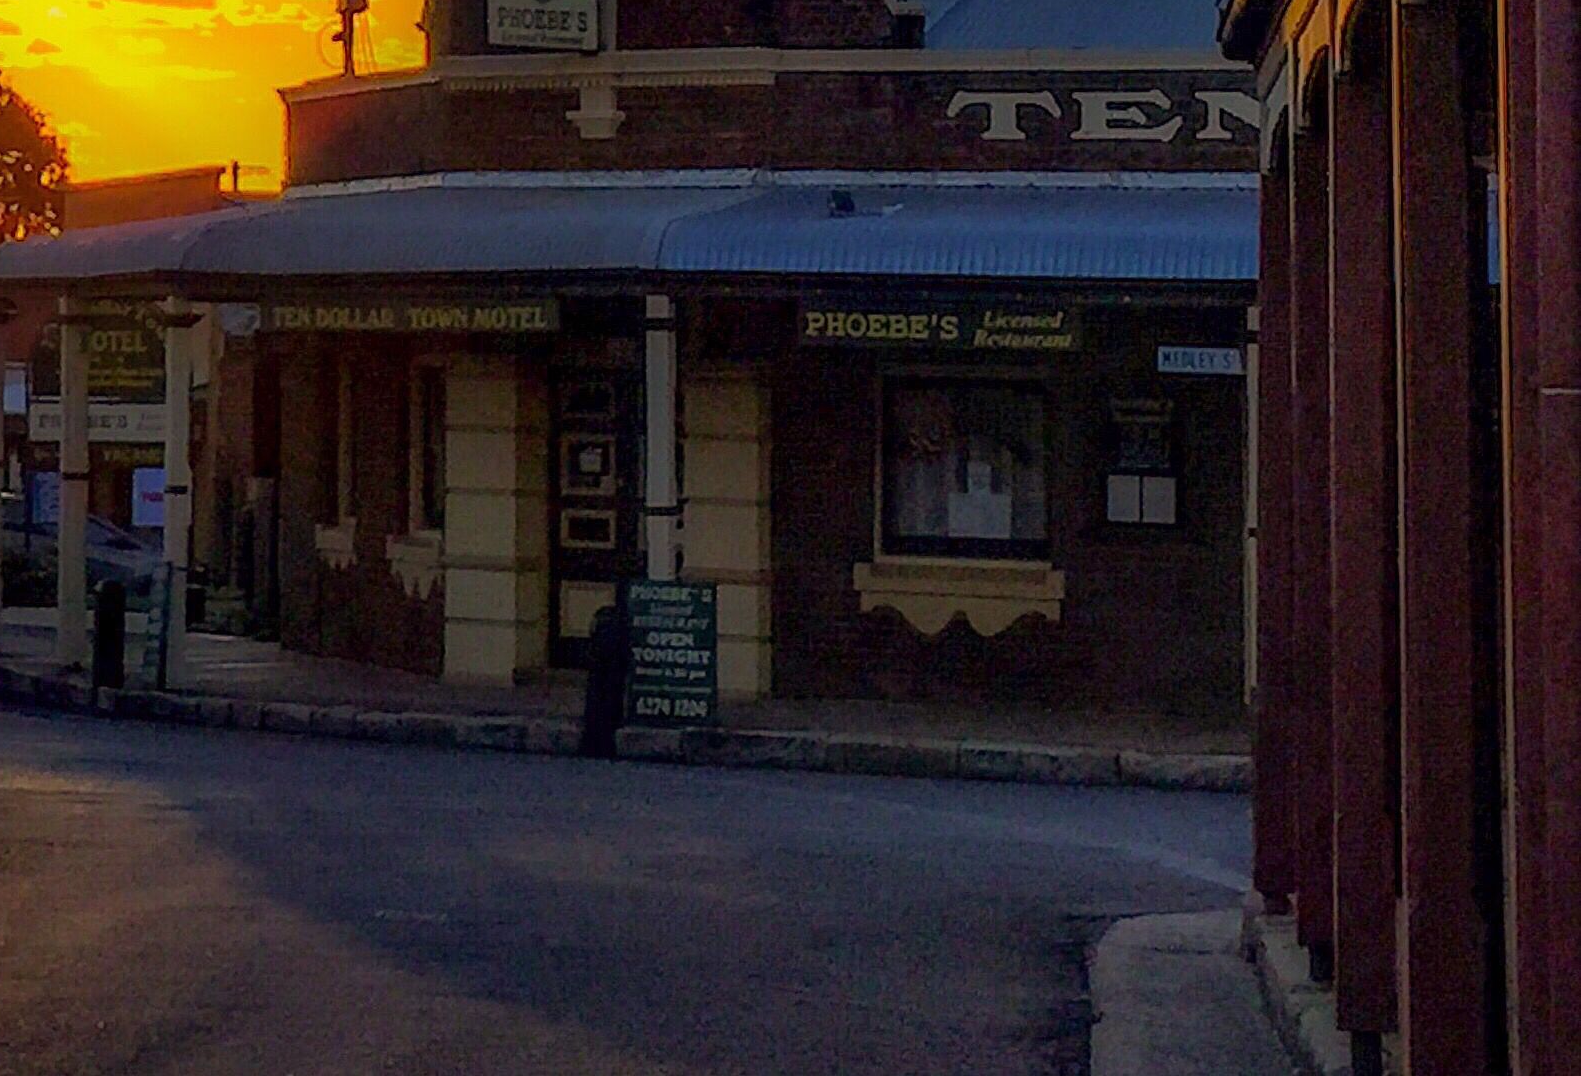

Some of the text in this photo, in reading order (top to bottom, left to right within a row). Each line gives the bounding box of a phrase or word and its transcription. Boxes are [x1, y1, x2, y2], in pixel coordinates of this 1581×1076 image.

[272, 305, 547, 329] TEN DOLLAR TOWN MOTEL
[805, 312, 960, 341] PHOEBE'S
[1161, 350, 1216, 369] MEDLEY
[646, 630, 695, 647] OPEN
[631, 647, 711, 665] TONIGHT
